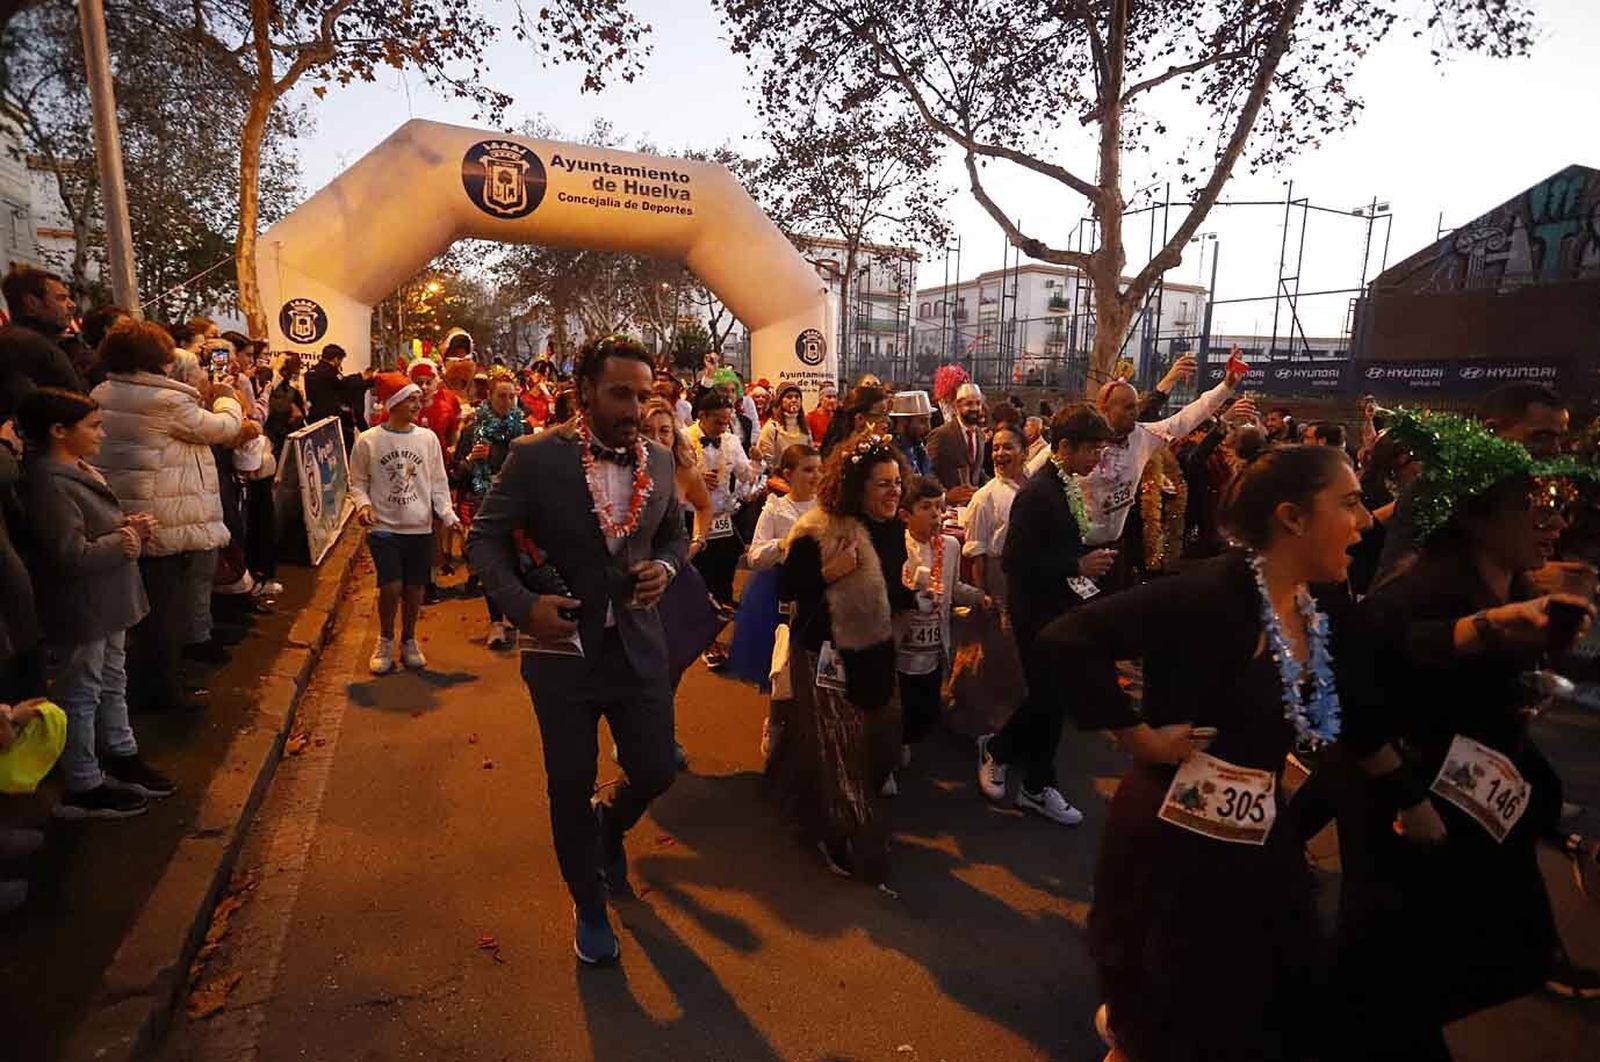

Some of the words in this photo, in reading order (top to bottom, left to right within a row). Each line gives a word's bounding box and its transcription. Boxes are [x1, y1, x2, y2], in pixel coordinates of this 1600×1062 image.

[550, 154, 690, 184] Ayuntamiento
[592, 176, 617, 192] de
[623, 179, 691, 201] Huelva
[624, 200, 639, 210] de
[642, 201, 694, 216] Deportes
[1293, 368, 1340, 379] HYUNDAI
[1386, 367, 1444, 378] HYUNDAI
[1486, 367, 1557, 378] HYUNDAI
[916, 627, 941, 644] 419
[1216, 786, 1266, 823] 305
[1486, 778, 1521, 820] 146
